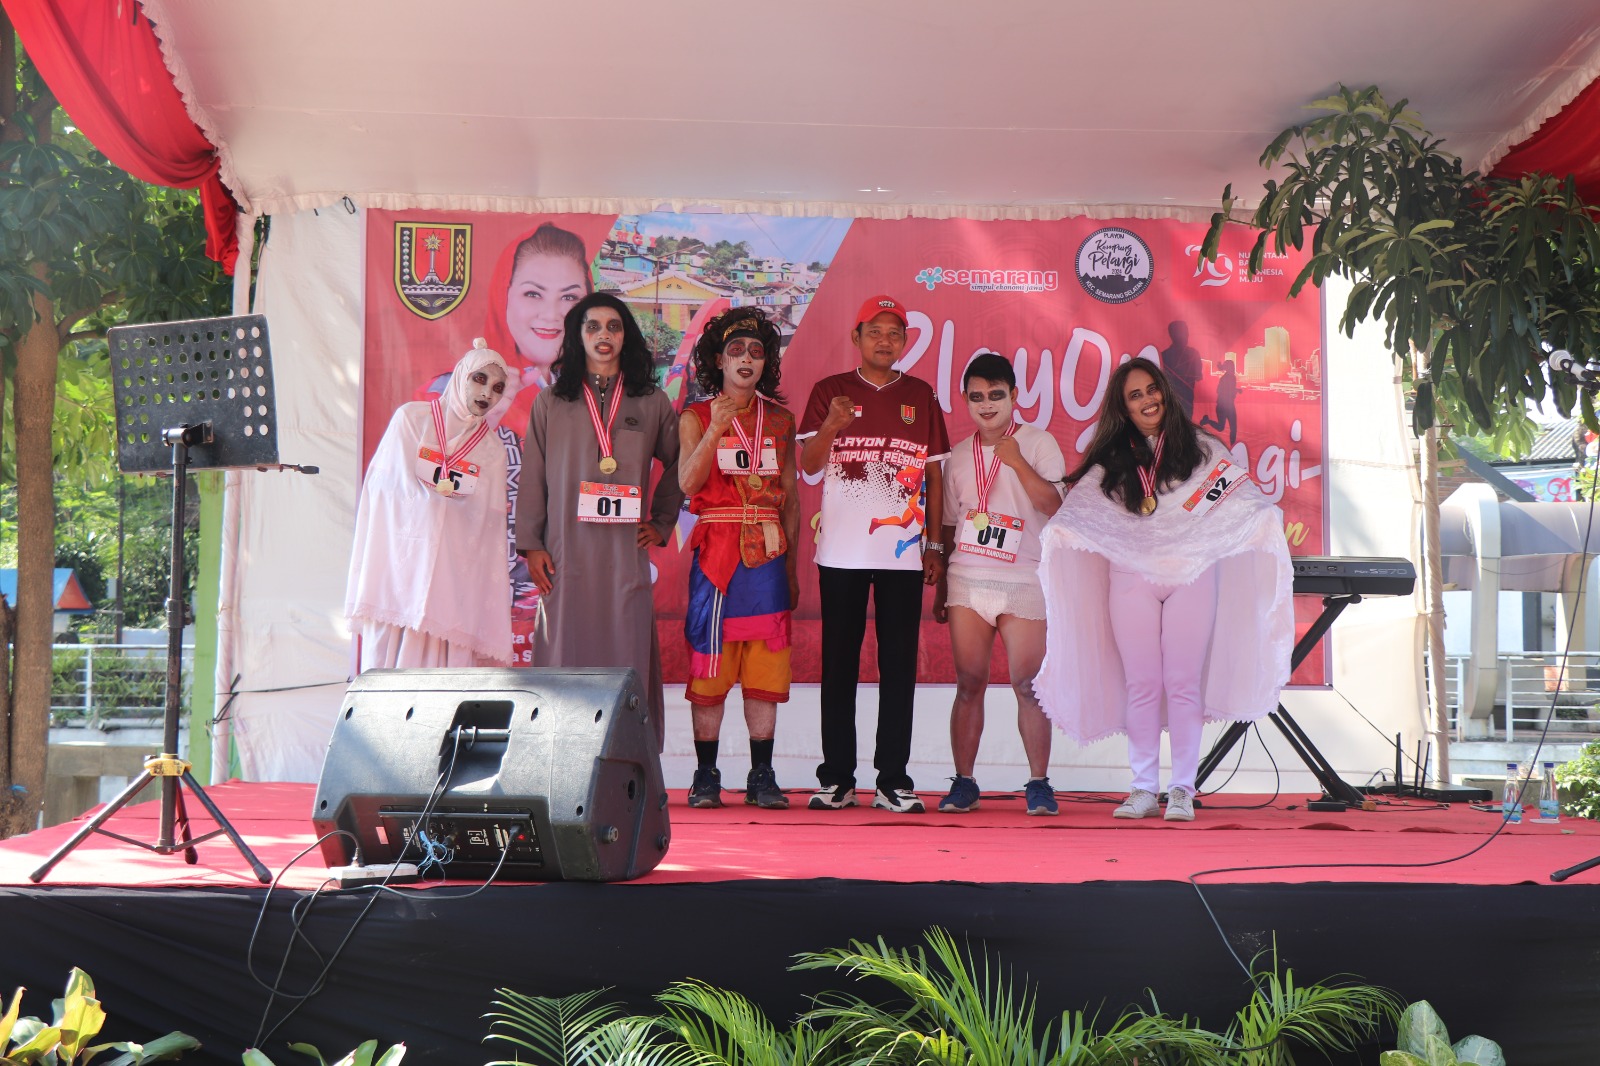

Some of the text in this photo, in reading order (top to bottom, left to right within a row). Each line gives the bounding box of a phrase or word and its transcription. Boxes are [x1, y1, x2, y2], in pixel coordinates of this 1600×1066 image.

[1088, 251, 1140, 274] Pelangi
[943, 270, 1058, 290] semarang
[970, 284, 1044, 292] simpul ekonomi jawa
[1095, 289, 1124, 299] SEMARANG
[1124, 280, 1144, 297] SELATAN
[832, 436, 928, 454] PLAYON 2024
[829, 450, 926, 469] KAMPUNG PELANGI
[1206, 477, 1232, 501] 02
[597, 497, 621, 516] 01
[978, 525, 1006, 549] 04
[986, 549, 1014, 561] RANDUSARI
